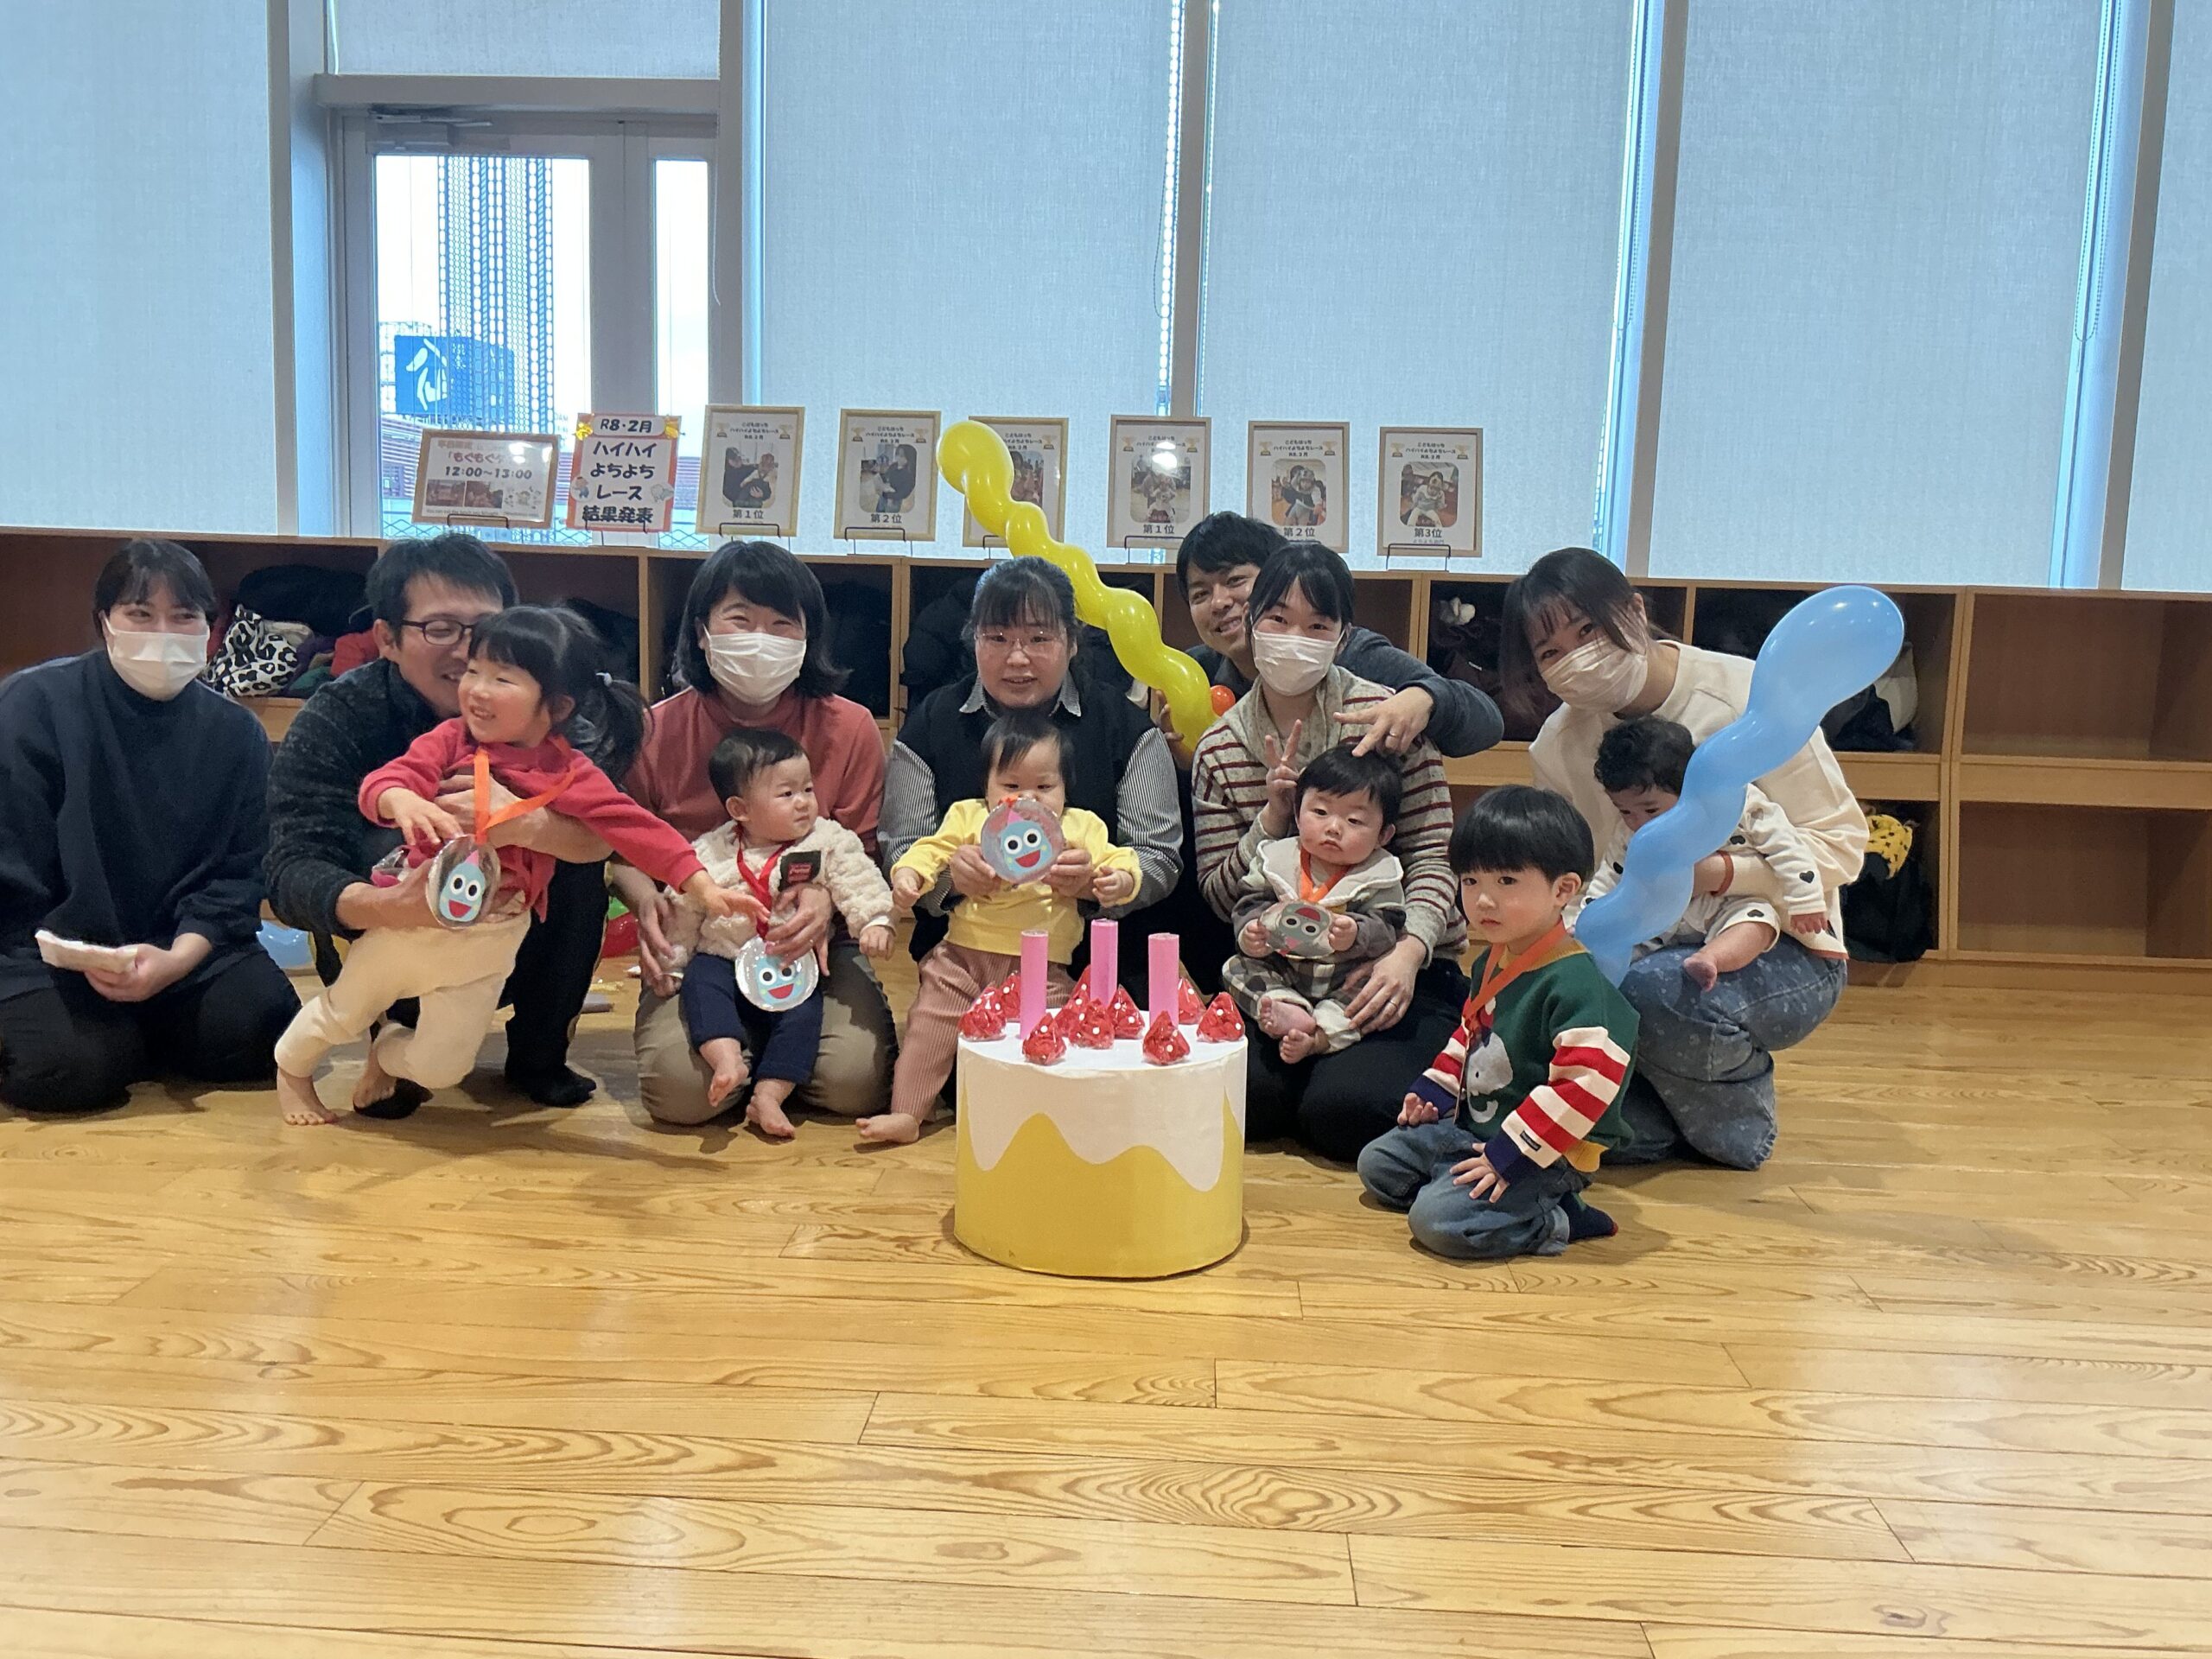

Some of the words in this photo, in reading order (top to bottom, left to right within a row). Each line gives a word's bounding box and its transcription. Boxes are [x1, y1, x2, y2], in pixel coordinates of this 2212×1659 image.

[593, 441, 657, 458] ハイハイ
[590, 462, 656, 480] よちよち
[596, 484, 643, 500] レース
[582, 505, 654, 524] 結果発表
[733, 509, 764, 519] 第1位
[870, 513, 902, 524] 第2位
[1143, 524, 1175, 534] 第1位
[1283, 527, 1316, 537] 第2位
[1414, 527, 1442, 538] 第3位
